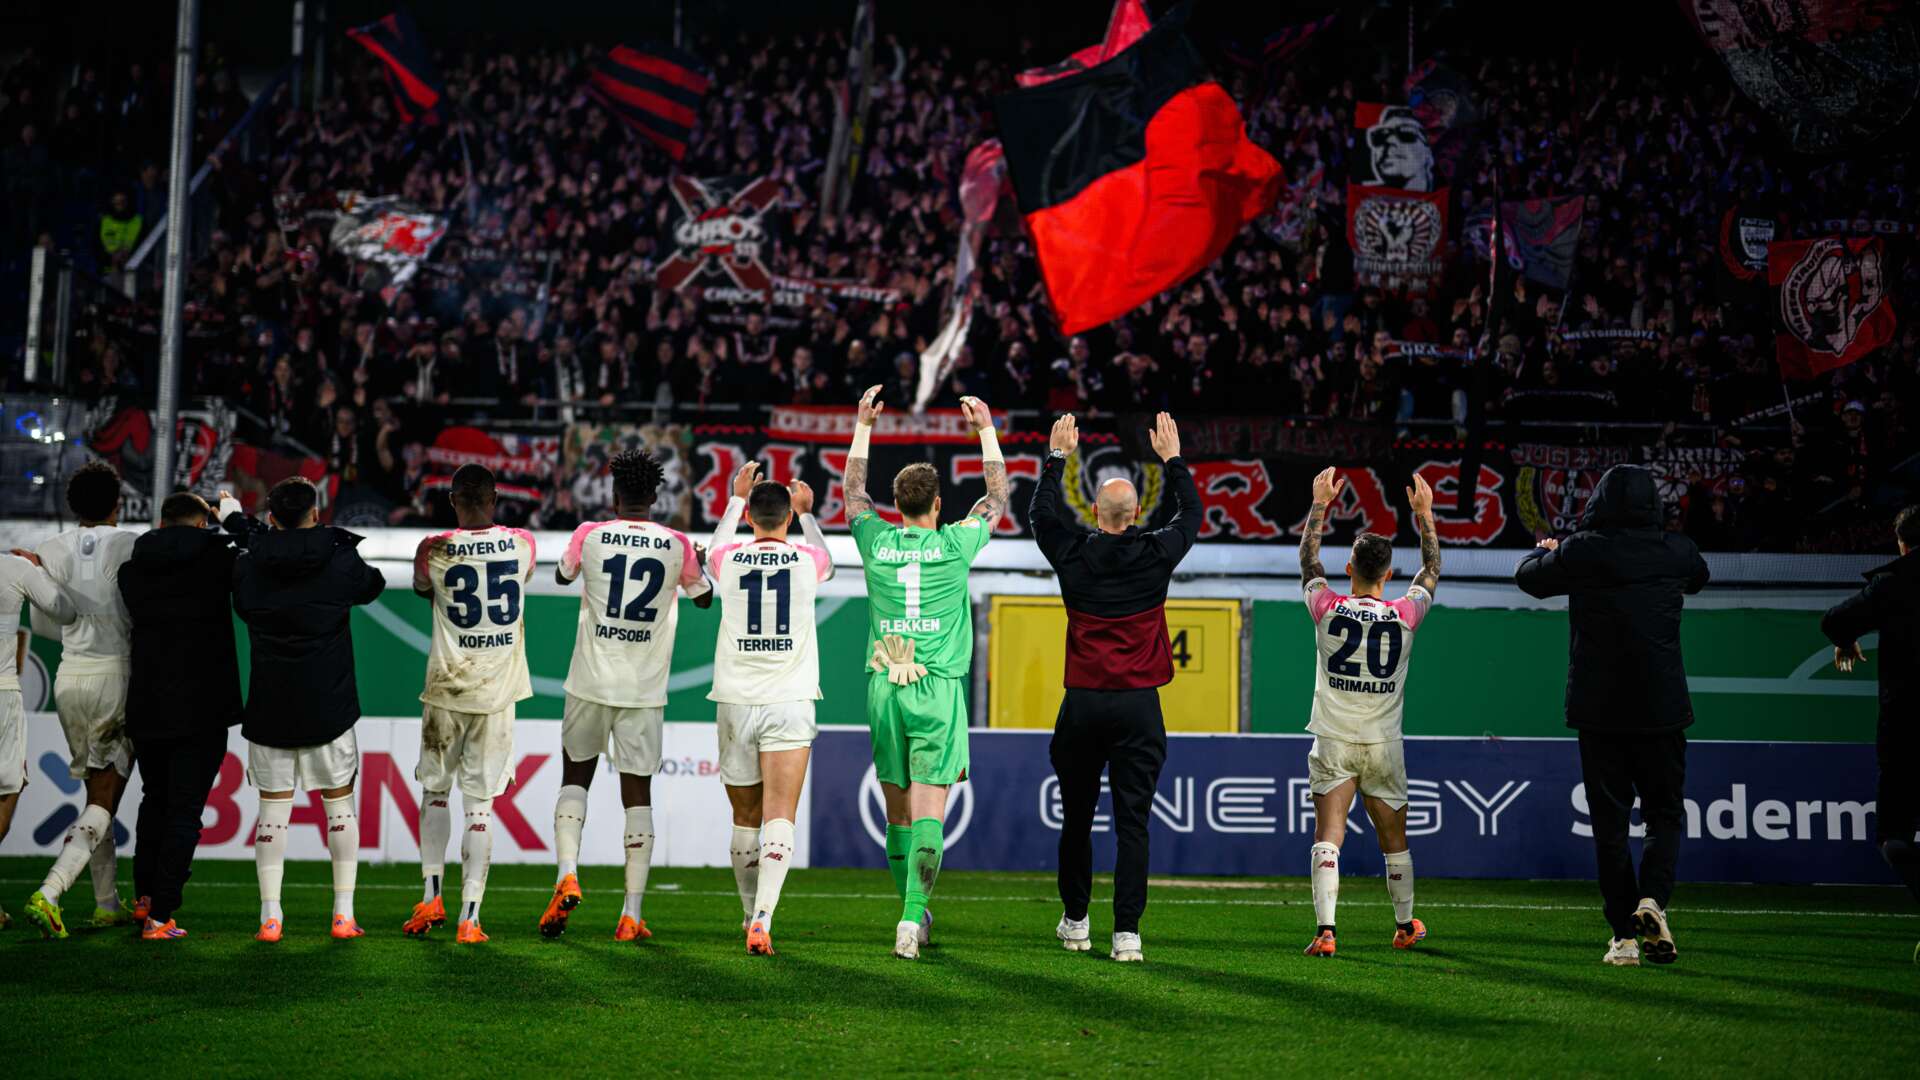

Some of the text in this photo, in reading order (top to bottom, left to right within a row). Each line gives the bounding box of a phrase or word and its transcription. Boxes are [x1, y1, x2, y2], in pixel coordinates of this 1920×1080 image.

[447, 538, 516, 556] BAYER 04
[601, 533, 672, 550] BAYER 04
[733, 551, 799, 565] BAYER 04
[877, 547, 943, 562] BAYER 04
[444, 559, 520, 629] 35
[603, 554, 665, 622] 12
[897, 562, 920, 618] 1
[739, 568, 791, 634] 11
[1336, 604, 1378, 621] BAYER
[1382, 610, 1398, 621] 04
[595, 624, 651, 643] TAPSOBA
[880, 618, 940, 633] FLEKKEN
[458, 633, 513, 648] KOFANE
[737, 638, 793, 651] TERRIER
[1328, 615, 1402, 679] 20
[1329, 677, 1395, 694] GRIMALDO
